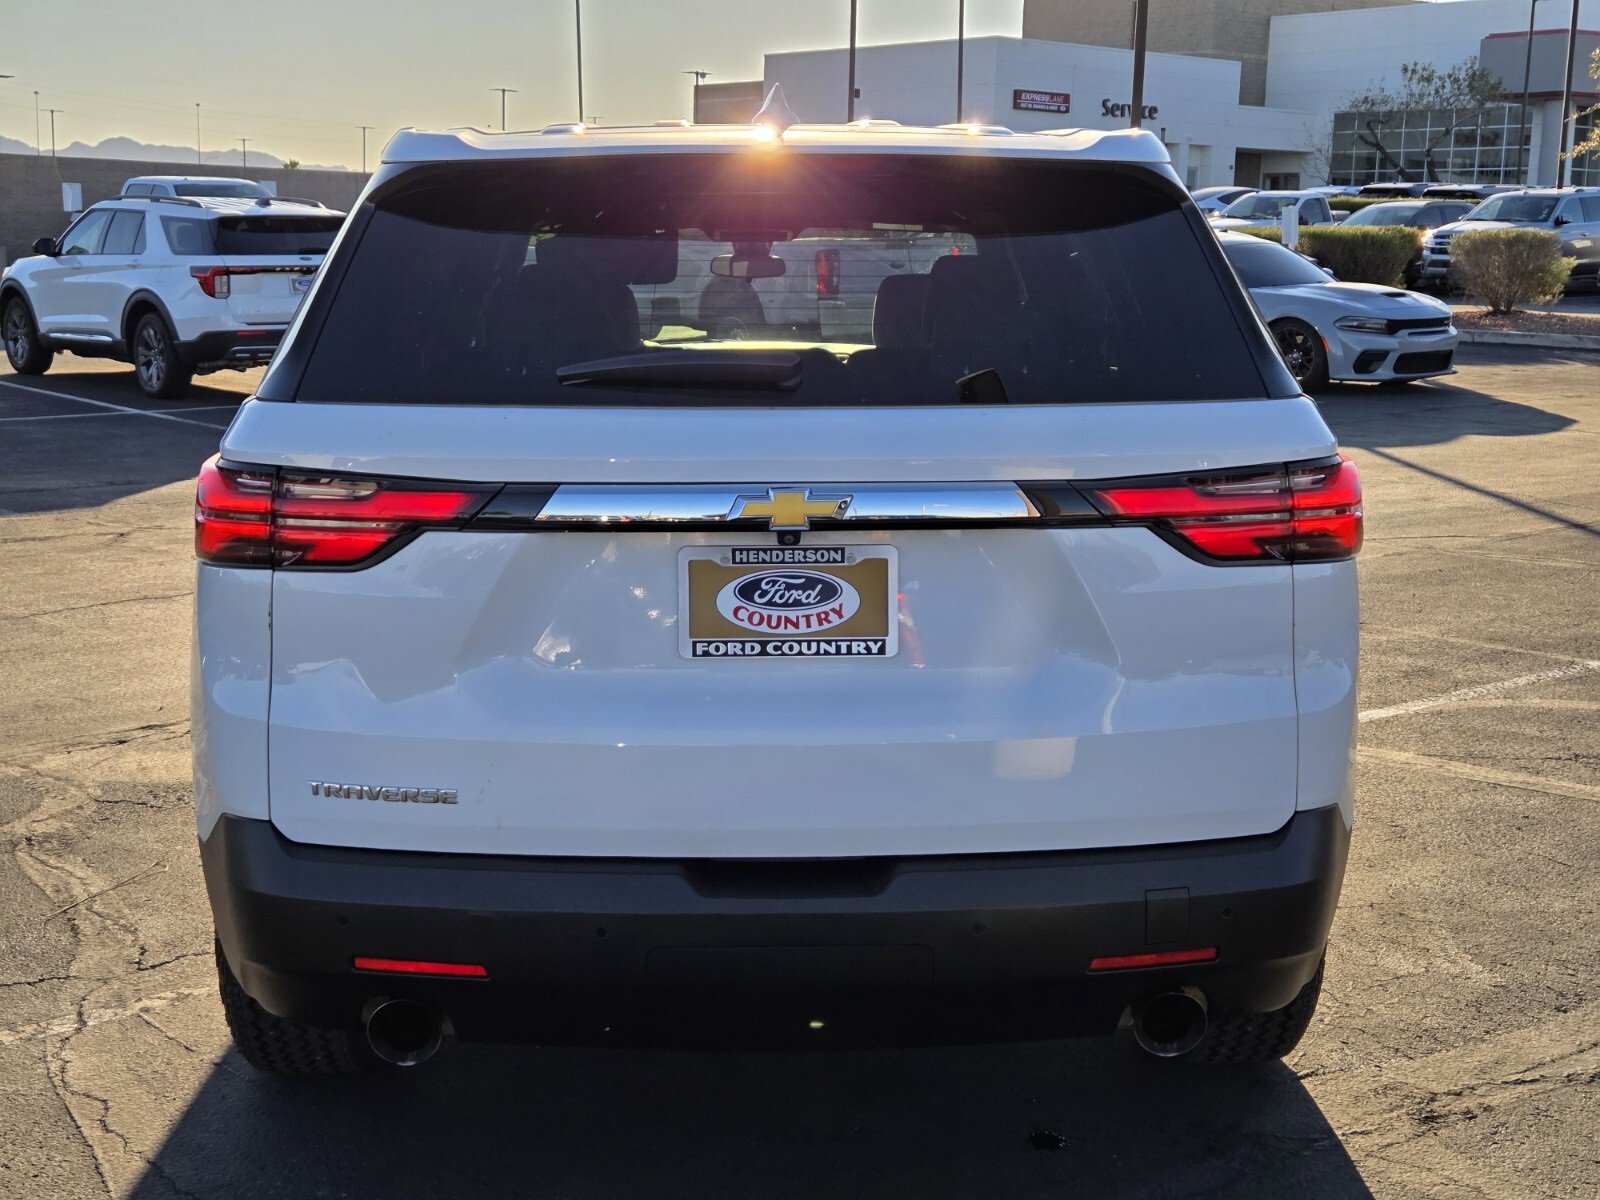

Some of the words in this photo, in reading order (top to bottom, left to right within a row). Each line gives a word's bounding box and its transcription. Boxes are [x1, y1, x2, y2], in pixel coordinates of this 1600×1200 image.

[1101, 98, 1158, 120] Serce
[735, 550, 842, 563] HENDERSON
[754, 577, 821, 603] Ford
[733, 603, 844, 630] COUNTRY
[696, 642, 761, 655] FORD
[766, 641, 882, 655] COUNTRY
[307, 780, 458, 804] TRAVERSE
